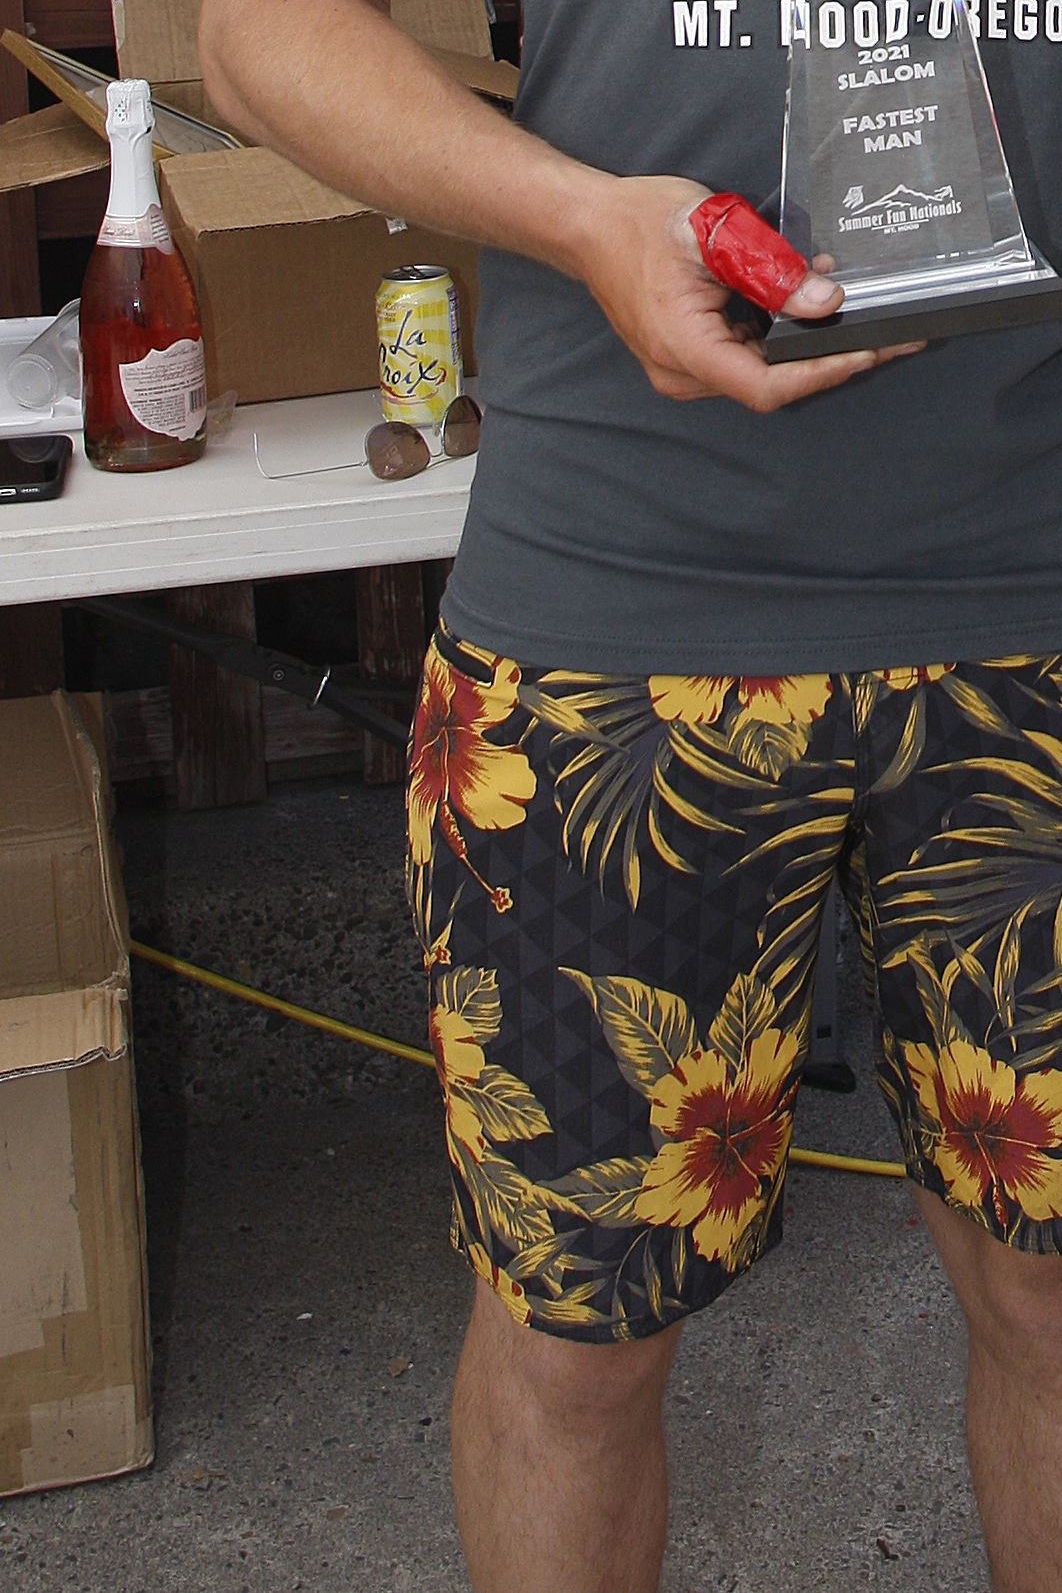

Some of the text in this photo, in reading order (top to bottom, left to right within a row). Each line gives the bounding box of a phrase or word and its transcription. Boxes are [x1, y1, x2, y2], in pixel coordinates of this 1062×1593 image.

[858, 44, 910, 65] 2021
[838, 61, 935, 91] SLALOM
[843, 105, 938, 135] FASTEST
[863, 130, 922, 154] MAN
[838, 200, 962, 233] Summer Fun Nationals
[390, 309, 427, 359] La
